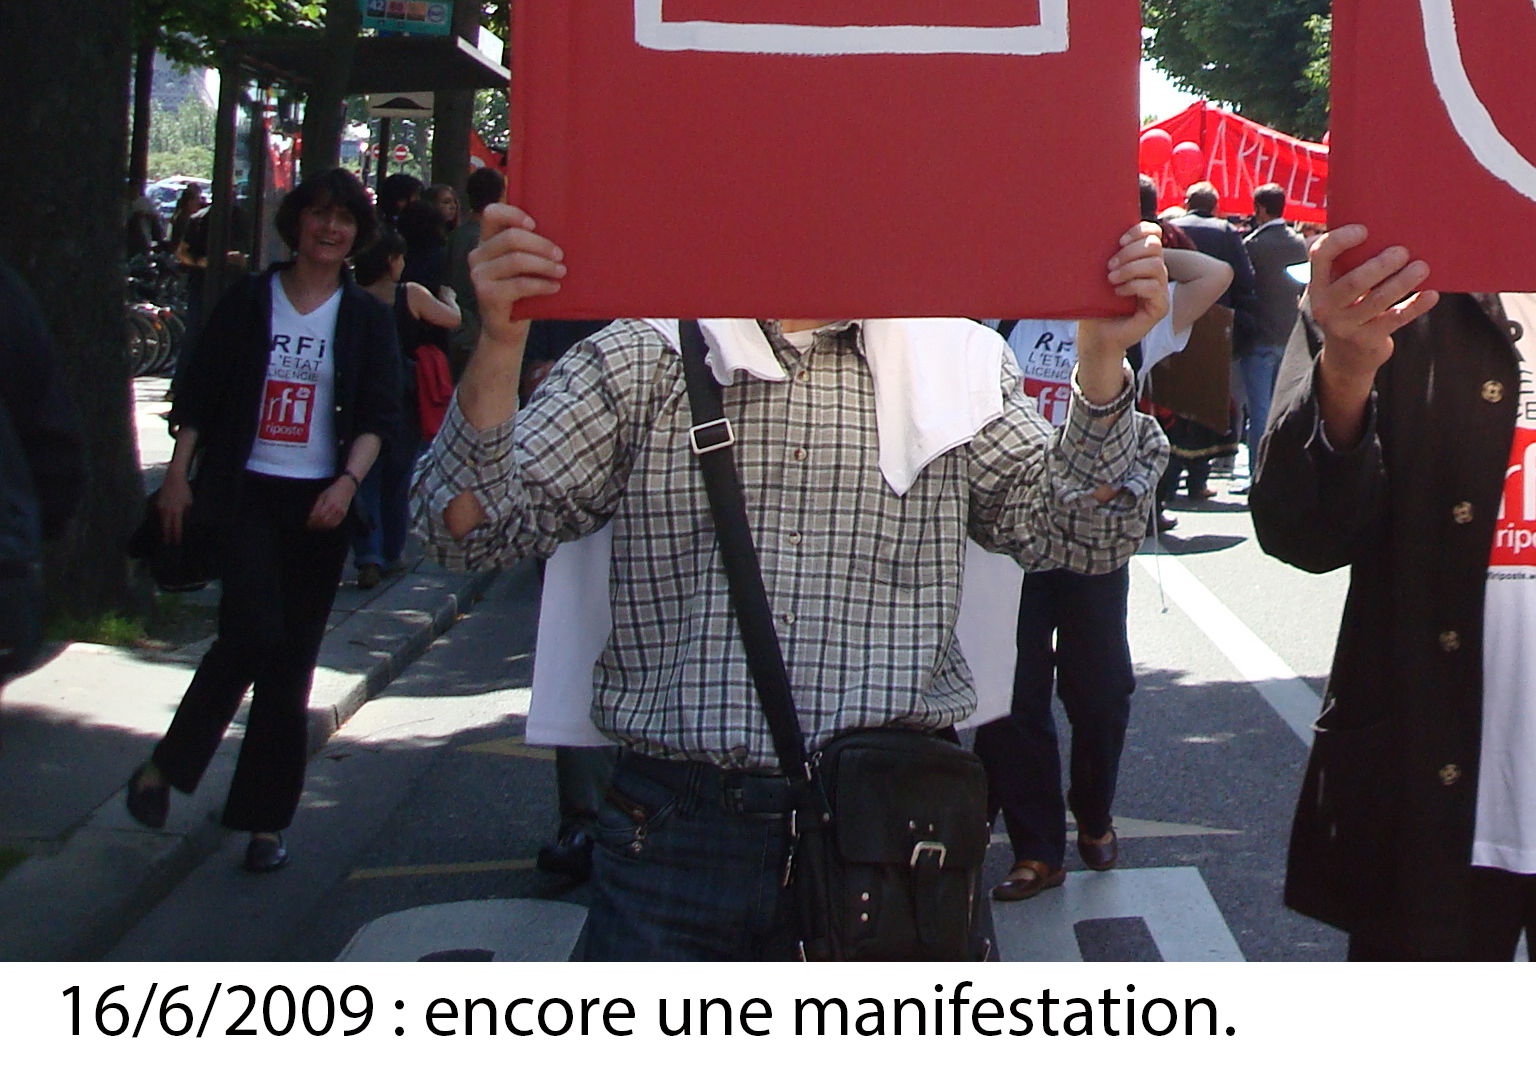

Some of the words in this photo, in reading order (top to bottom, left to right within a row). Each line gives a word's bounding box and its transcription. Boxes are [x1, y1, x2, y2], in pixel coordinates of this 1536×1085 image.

[1034, 332, 1074, 354] RF
[1028, 351, 1078, 369] L'ETA
[1024, 365, 1072, 380] LICENC
[266, 387, 312, 424] rfi
[1038, 387, 1070, 427] fi
[265, 422, 304, 437] riposte
